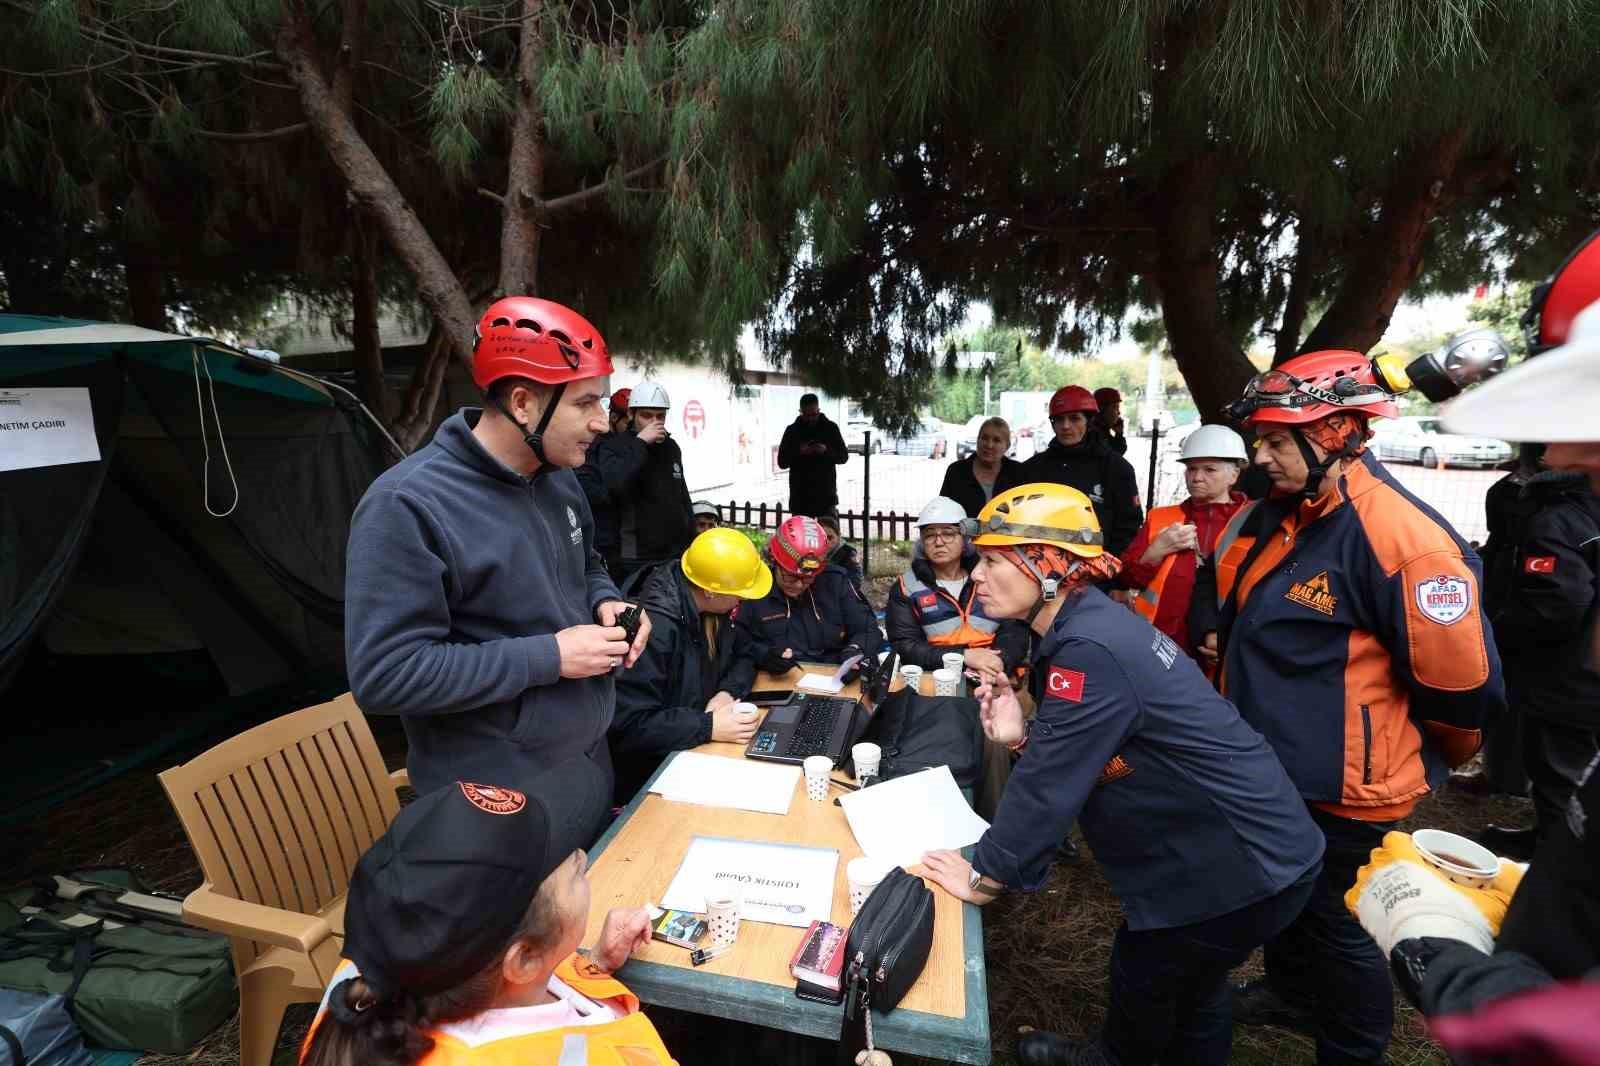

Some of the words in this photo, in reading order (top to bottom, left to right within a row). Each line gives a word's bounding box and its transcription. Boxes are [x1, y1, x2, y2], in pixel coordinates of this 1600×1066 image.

[1308, 385, 1346, 405] uvex
[32, 420, 66, 430] ÇADIRI
[1289, 582, 1314, 599] MAG
[1431, 584, 1457, 592] AFAD
[1427, 593, 1464, 604] KENTSEL
